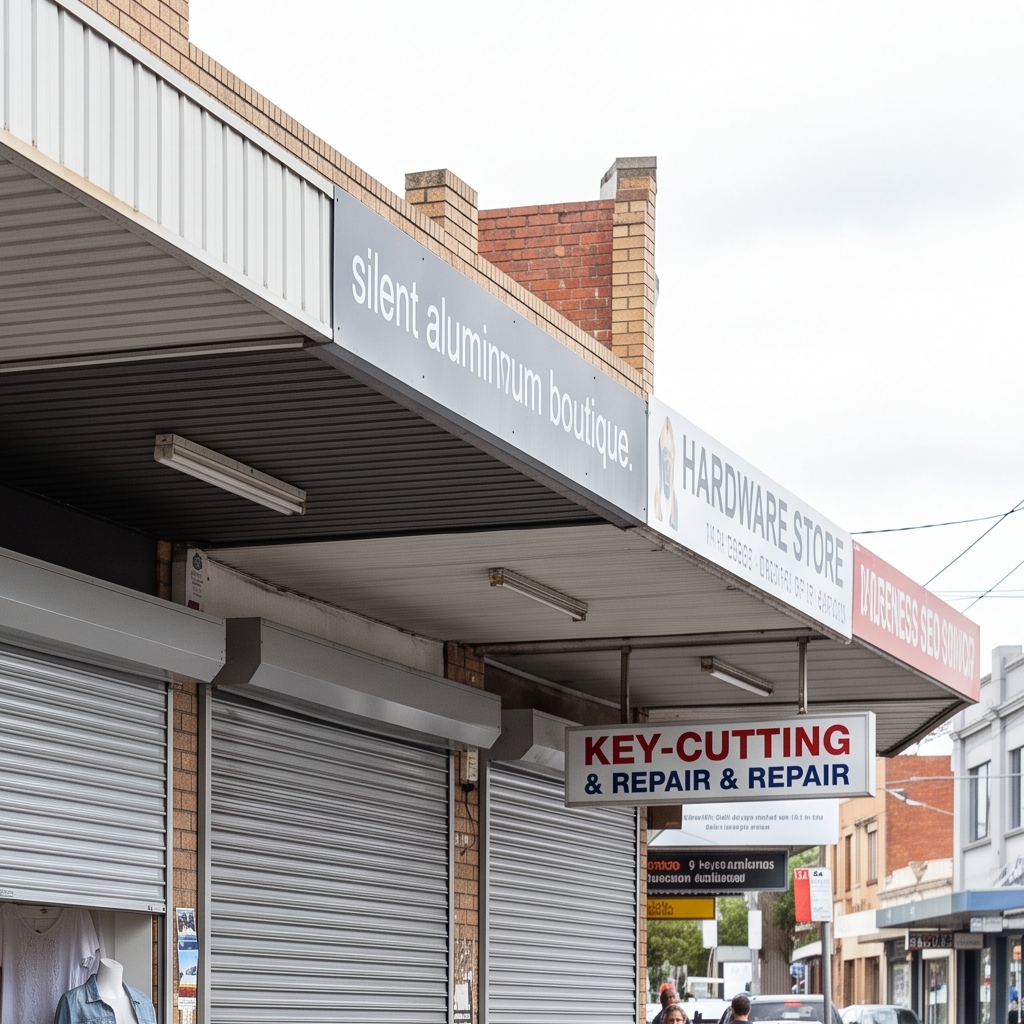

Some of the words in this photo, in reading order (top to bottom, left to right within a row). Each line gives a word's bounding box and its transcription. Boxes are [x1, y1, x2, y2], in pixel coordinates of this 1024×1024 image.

[351, 247, 419, 340] silent
[549, 369, 633, 472] boutique.
[682, 433, 788, 554] HARDWARE
[792, 509, 844, 589] STORE
[584, 723, 851, 766] KEY-CUTTING
[584, 773, 603, 795] &
[612, 769, 711, 794] REPAIR
[720, 767, 738, 790] &
[748, 763, 850, 789] REPAIR
